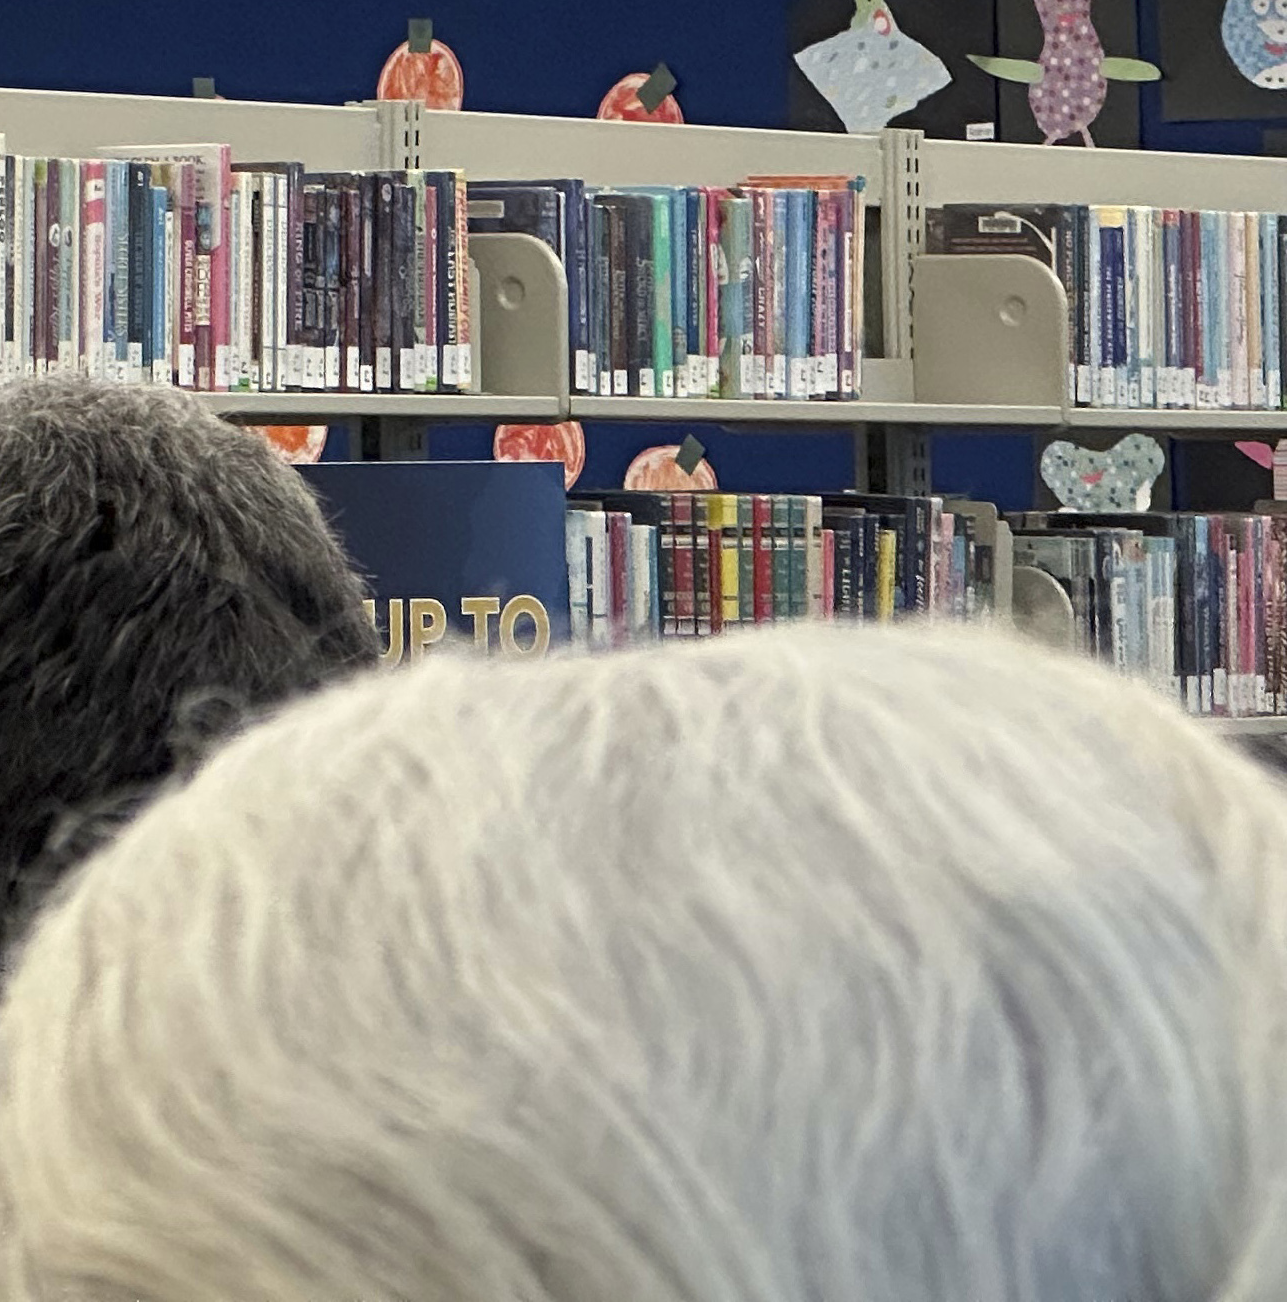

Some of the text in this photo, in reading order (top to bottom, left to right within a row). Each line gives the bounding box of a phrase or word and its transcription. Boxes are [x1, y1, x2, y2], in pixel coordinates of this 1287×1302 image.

[294, 222, 303, 265] RING
[294, 290, 303, 332] FIRE
[362, 595, 551, 666] UP TO
